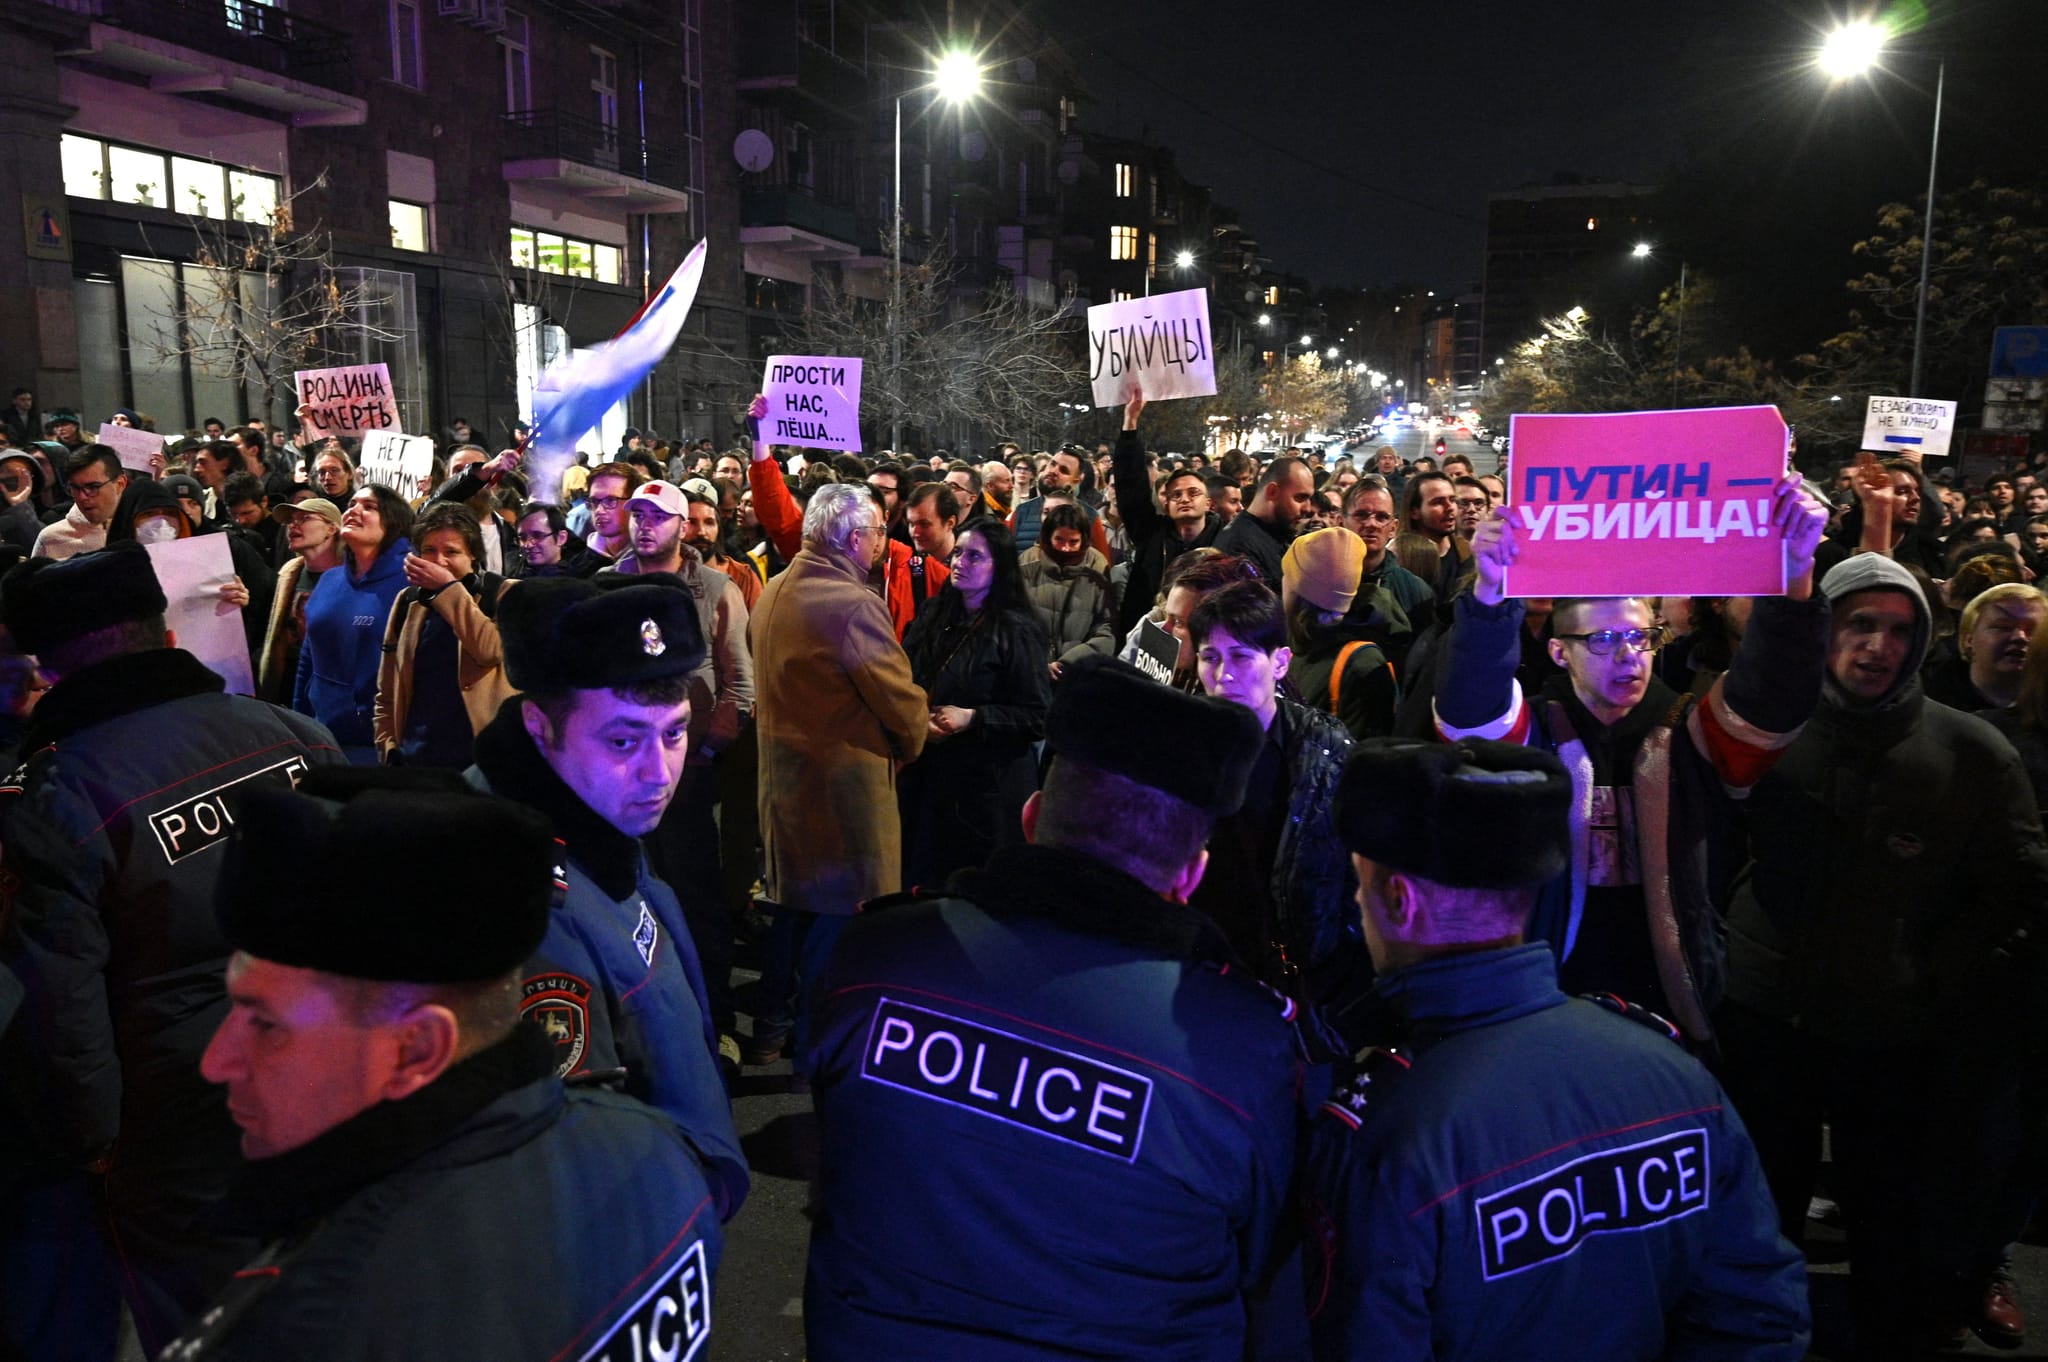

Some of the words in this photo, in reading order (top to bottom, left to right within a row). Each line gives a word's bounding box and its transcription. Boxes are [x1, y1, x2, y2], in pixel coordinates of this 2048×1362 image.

[1091, 314, 1206, 381] УБИЙЦЫ
[302, 372, 386, 402] РОДИНА
[771, 364, 845, 386] ПРОСТИ
[311, 401, 393, 430] СМЕРТЬ
[785, 393, 829, 417] НАС,
[776, 417, 846, 442] ЛЁША...
[1878, 415, 1894, 428] НЕ
[377, 436, 412, 461] НЕТ
[1525, 462, 1710, 502] ПУТИН
[1519, 490, 1770, 543] УБИЙЦА!
[1135, 648, 1173, 686] БОЛЬНО
[161, 765, 302, 852] POLE
[524, 978, 579, 995] ՐԵՎԱՆ
[874, 1016, 1133, 1145] POLICE
[1491, 1146, 1701, 1265] POLICE
